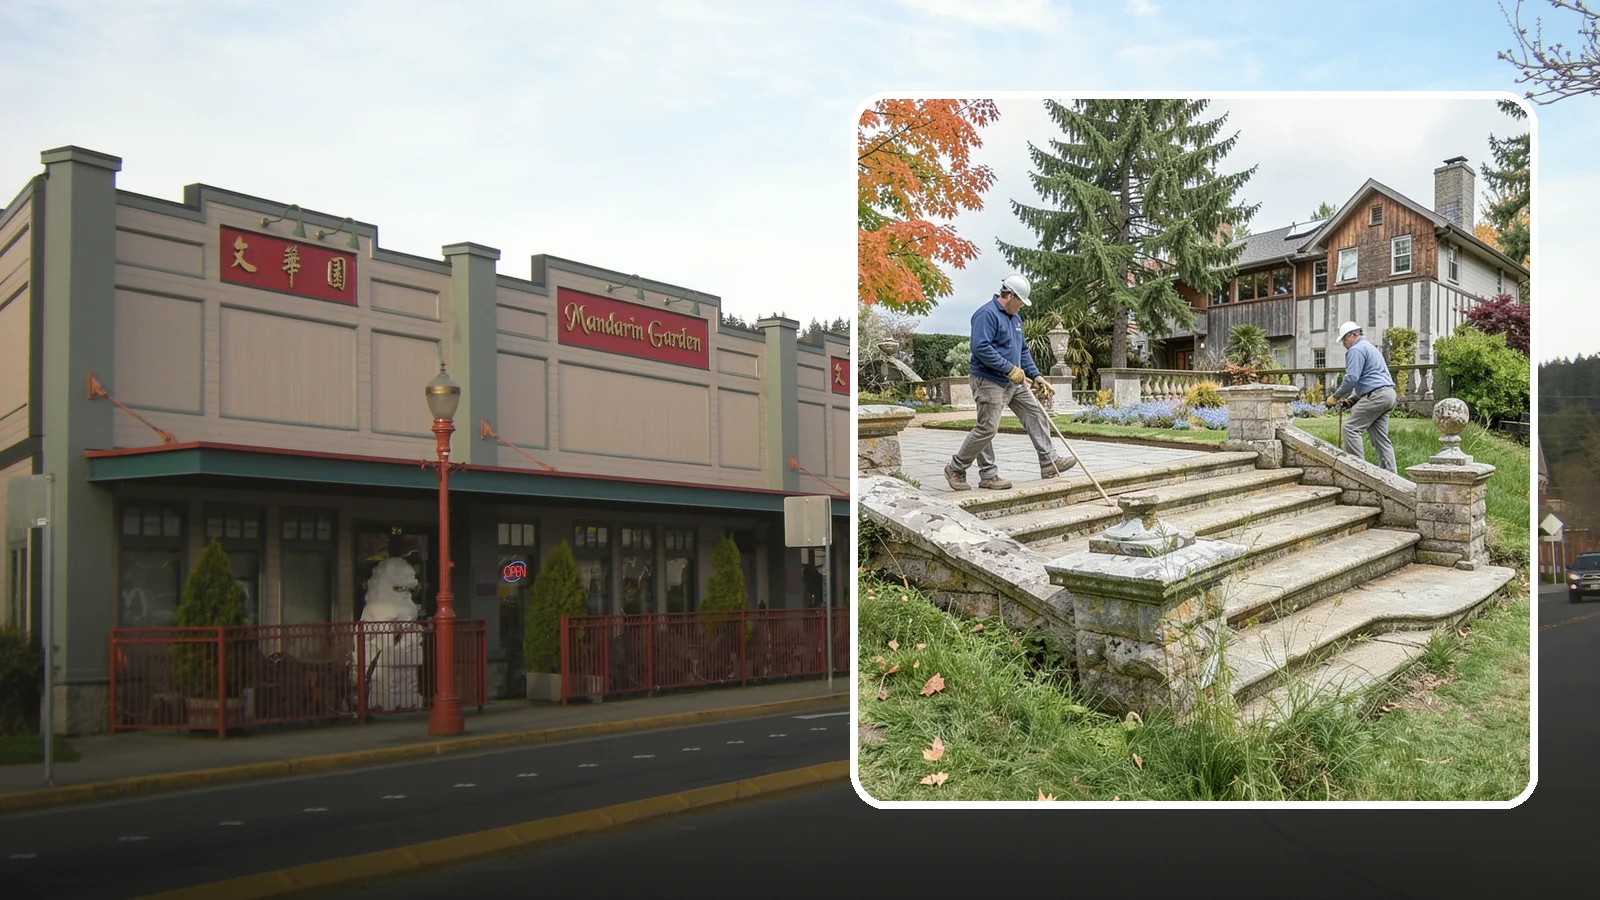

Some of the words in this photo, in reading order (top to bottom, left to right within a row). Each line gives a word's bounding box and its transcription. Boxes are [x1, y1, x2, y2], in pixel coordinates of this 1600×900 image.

[230, 235, 346, 291] 文華園
[564, 302, 644, 341] Mandarin
[647, 320, 702, 352] Garden
[503, 565, 527, 578] OPEN
